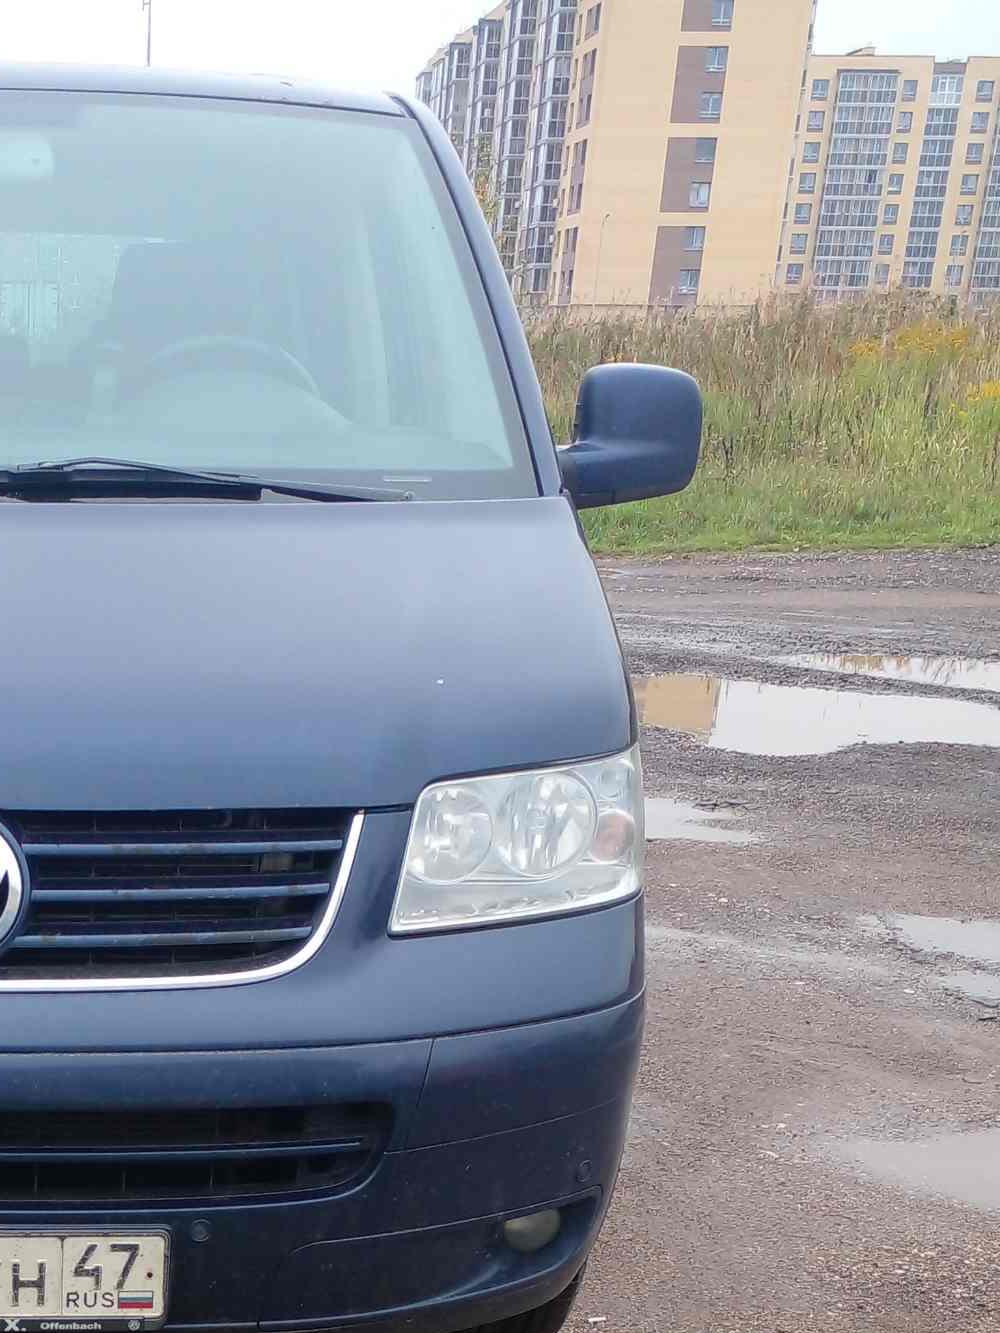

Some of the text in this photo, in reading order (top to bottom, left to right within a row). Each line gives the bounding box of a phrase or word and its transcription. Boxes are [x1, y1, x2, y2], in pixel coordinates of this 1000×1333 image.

[74, 1243, 140, 1291] 47
[66, 1292, 114, 1308] RUS
[40, 1321, 102, 1331] Offenbach
